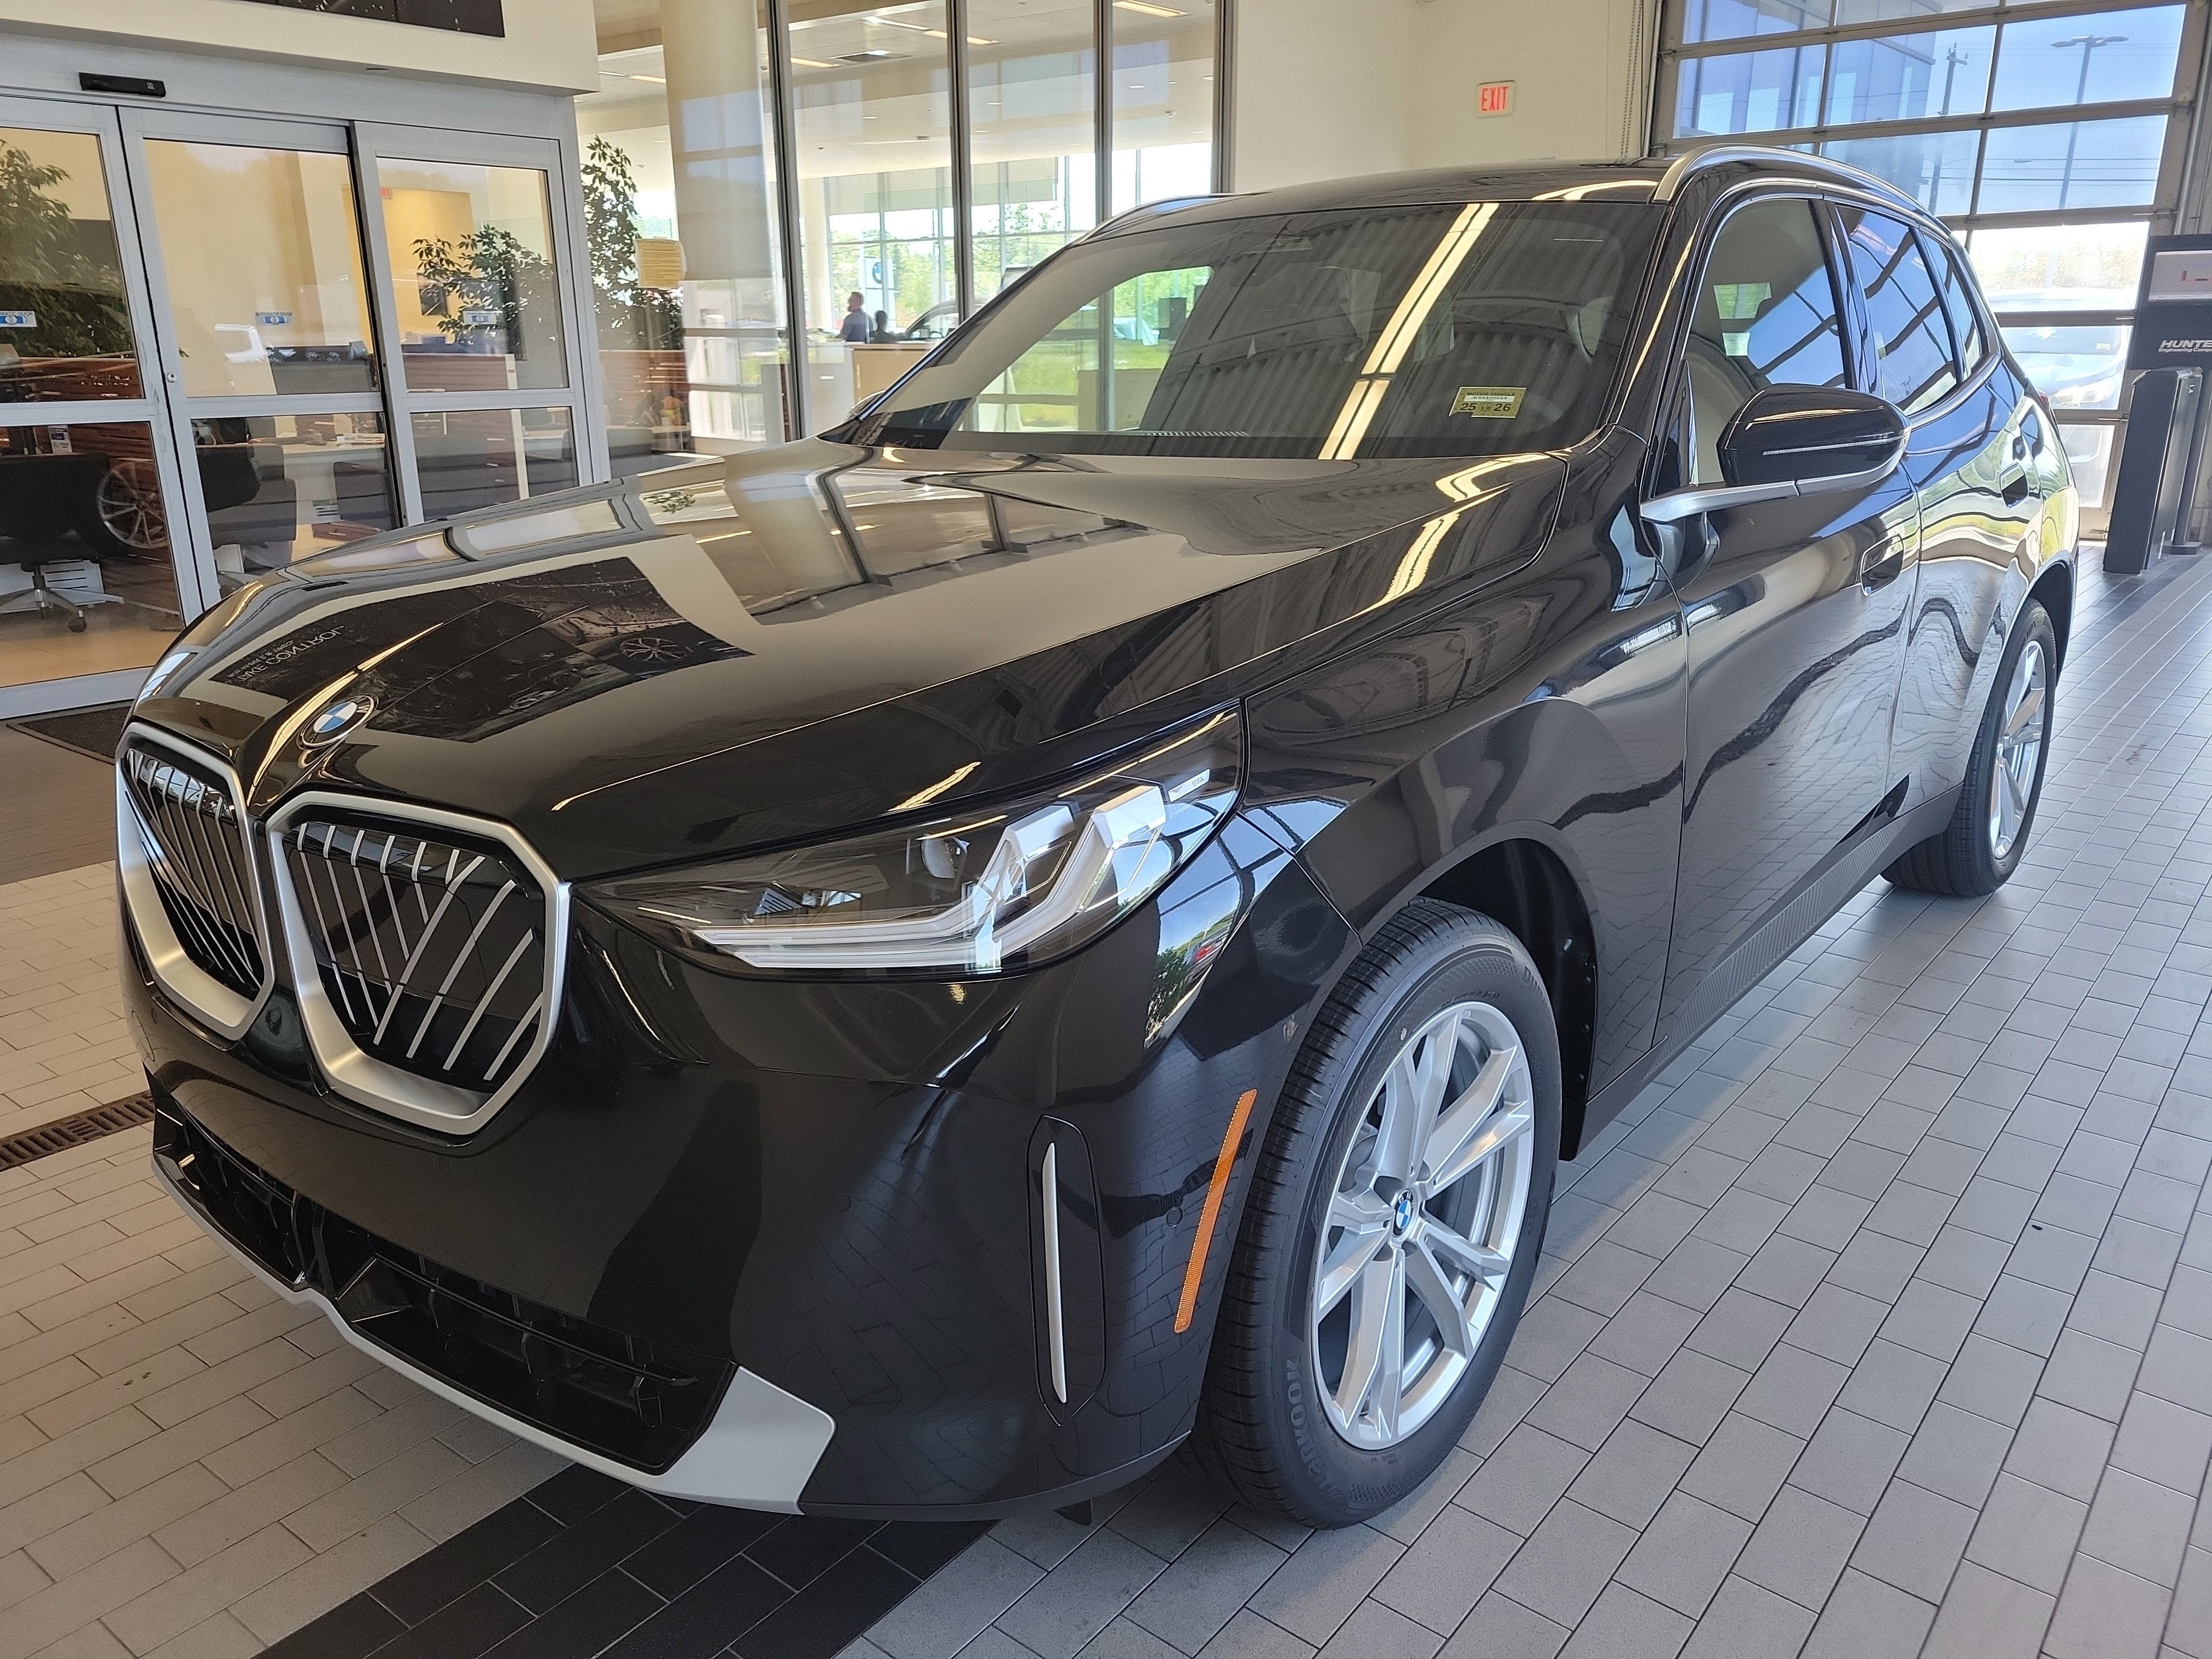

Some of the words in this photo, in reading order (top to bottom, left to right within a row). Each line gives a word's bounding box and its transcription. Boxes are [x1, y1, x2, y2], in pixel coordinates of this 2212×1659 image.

[1481, 86, 1509, 111] EXIT
[1459, 403, 1477, 411] 25
[1493, 403, 1512, 411] 26
[1191, 775, 1205, 787] BMW
